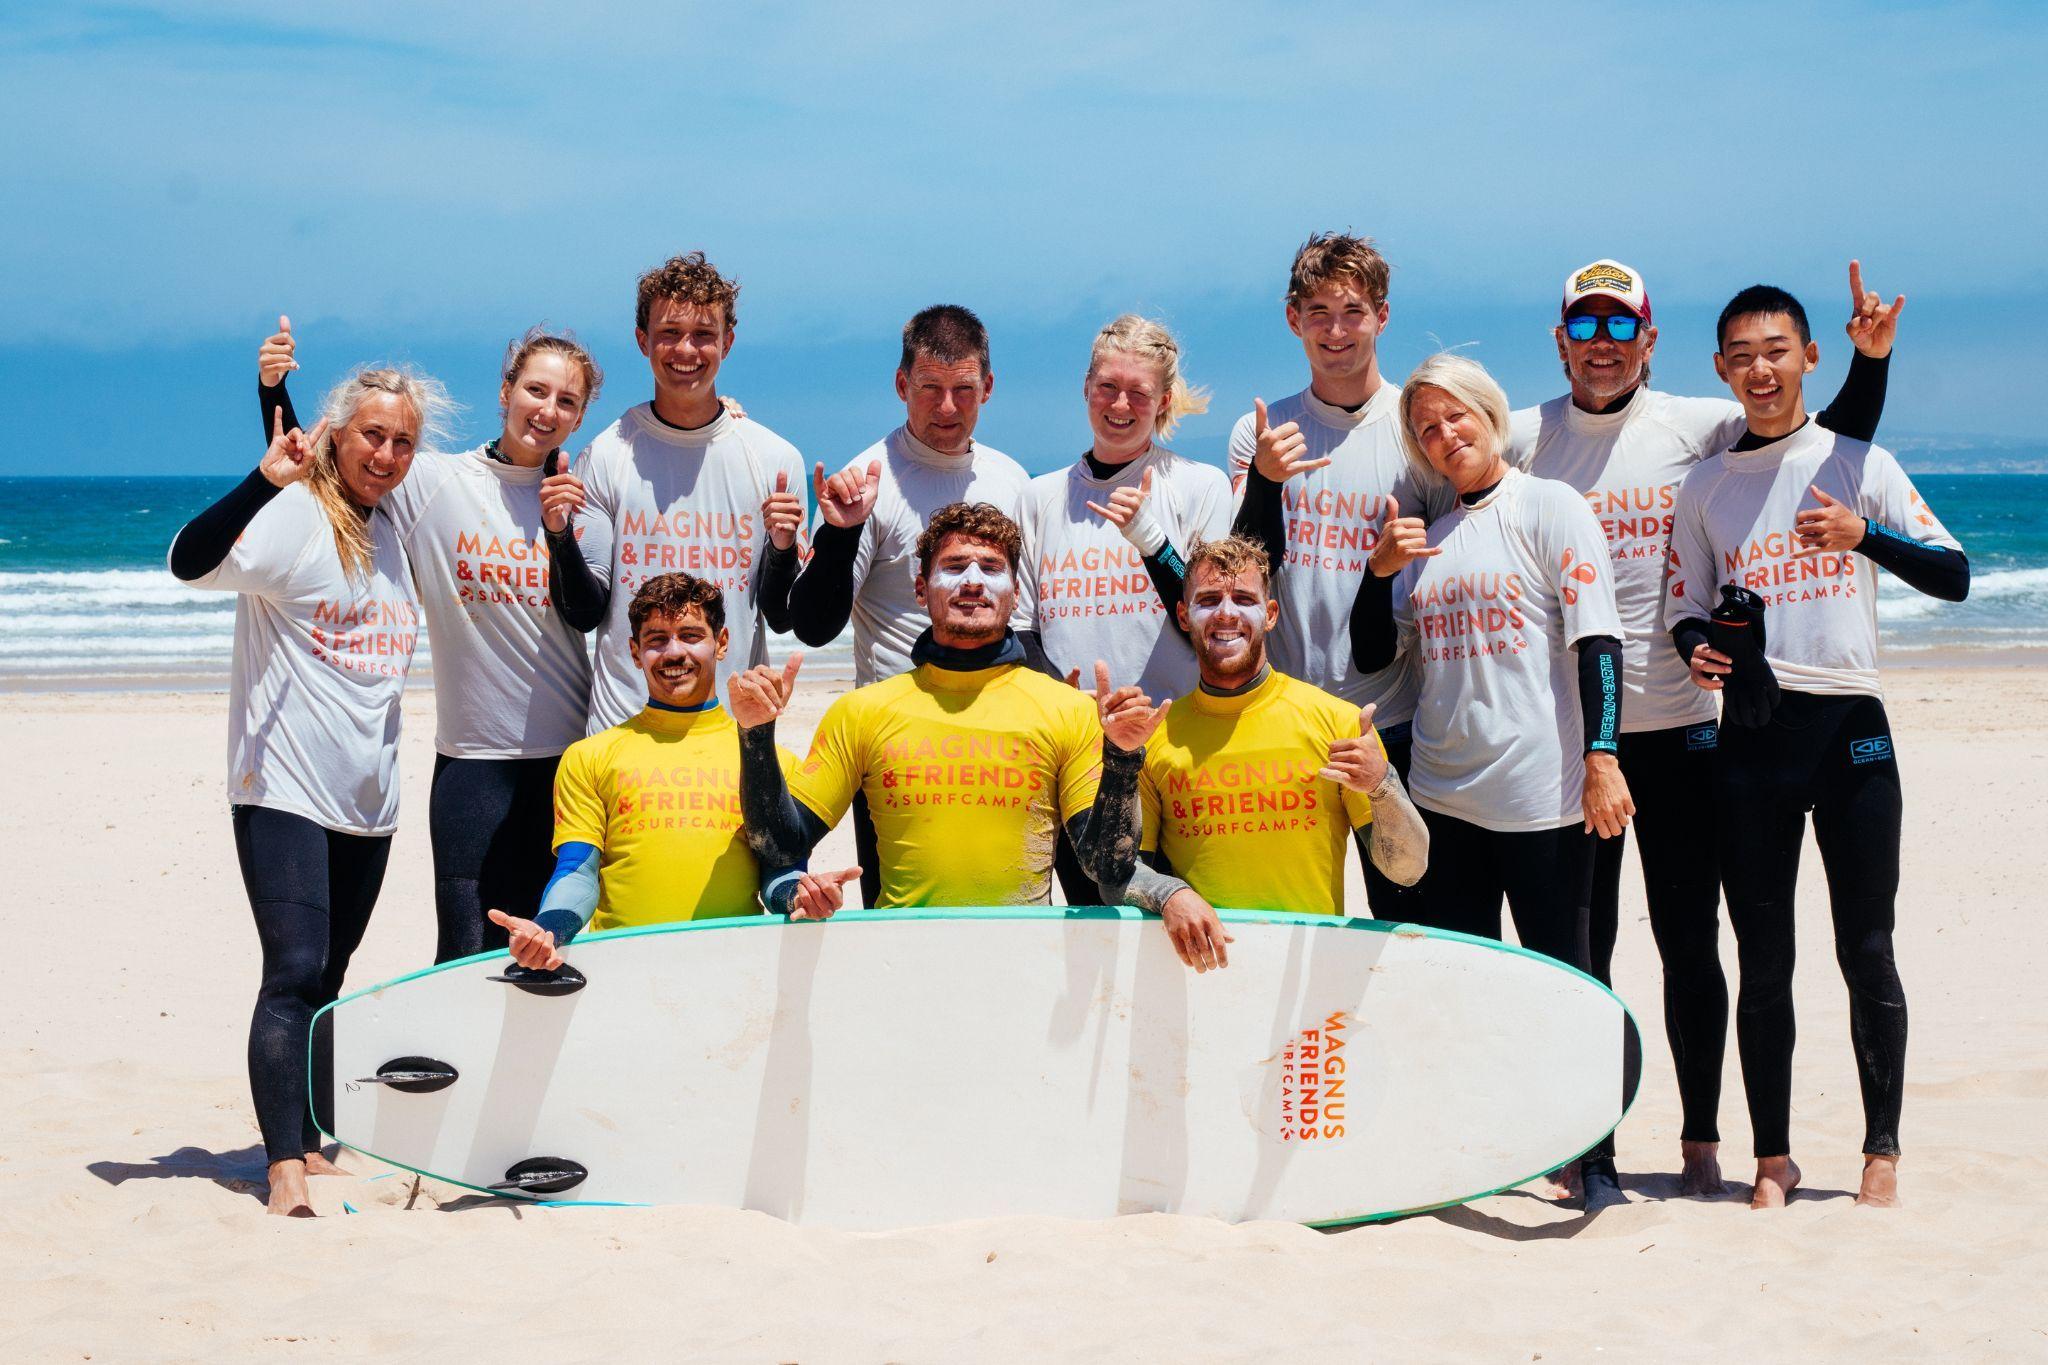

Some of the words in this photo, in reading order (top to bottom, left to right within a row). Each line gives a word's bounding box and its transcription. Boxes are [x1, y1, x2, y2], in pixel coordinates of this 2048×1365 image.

[1282, 485, 1380, 522] AGNU
[1584, 486, 1674, 515] GNUS
[622, 510, 753, 540] MAGNUS
[1287, 519, 1379, 551] FRIEND
[1600, 515, 1674, 541] ENDS
[457, 528, 550, 562] MAGN
[620, 542, 639, 566] &
[644, 543, 753, 570] FRIENDS
[1725, 529, 1806, 575] MAGN
[457, 559, 474, 582] &
[480, 562, 550, 588] FRIE
[1040, 545, 1144, 576] MAGNU
[1282, 549, 1362, 572] SURFCAM
[1744, 554, 1855, 590] FRIENDS
[478, 590, 551, 608] SURFCA
[1052, 573, 1157, 600] FRIEND
[1411, 572, 1522, 613] MAGNUS
[1762, 584, 1841, 608] RFCAMP
[312, 598, 418, 627] MAGNUS
[1049, 601, 1148, 619] SURFCAMP
[1422, 606, 1525, 640] FRIENDS
[332, 631, 418, 657] FRIEND
[1427, 640, 1507, 662] URFAMP
[331, 655, 409, 678] SURFCAM
[881, 734, 1042, 765] MAGNUS
[617, 766, 740, 790] MAGNU
[882, 768, 898, 789] &
[905, 764, 1042, 792] FRIENDS
[1168, 759, 1317, 795] MAGNUS
[618, 795, 634, 816] &
[640, 791, 742, 816] FRIEND
[902, 793, 1021, 809] SURFCAMP
[1172, 799, 1187, 820] &
[1191, 789, 1317, 818] FRIENDS
[1193, 818, 1299, 838] SURFCAMP
[1282, 1040, 1294, 1124] RFCAMP
[1299, 1029, 1320, 1141] FRIENDS
[1323, 1010, 1347, 1139] MAGNUS
